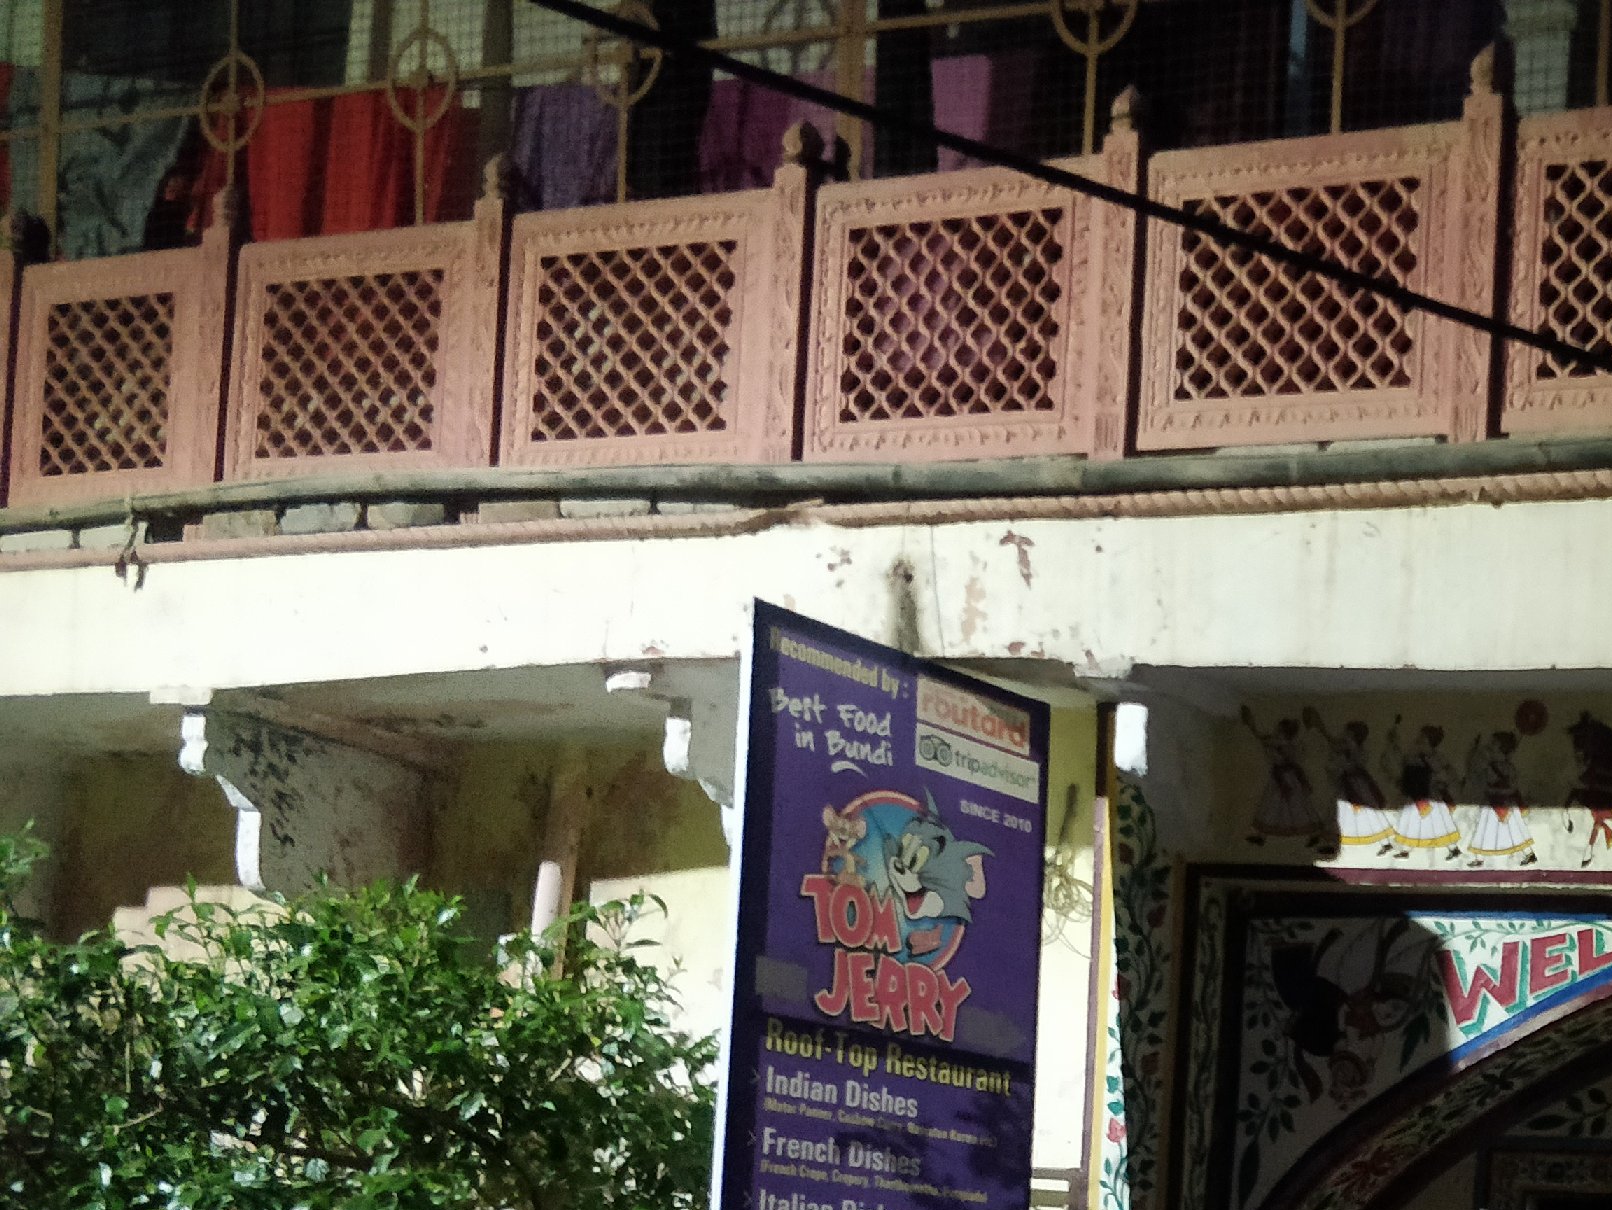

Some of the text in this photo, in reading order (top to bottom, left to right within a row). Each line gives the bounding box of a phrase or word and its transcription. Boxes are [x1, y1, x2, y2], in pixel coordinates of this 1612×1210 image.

[770, 688, 891, 737] Best Food
[922, 693, 1026, 748] routard
[796, 724, 893, 766] in Bundi
[960, 800, 1032, 833] SINCE 2010
[801, 875, 899, 952] TOM
[816, 948, 971, 1041] JERRY
[766, 1017, 1012, 1096] Roof-Top Restaurant
[766, 1065, 918, 1118] Indian Dishes
[762, 1126, 921, 1176] French Dishes
